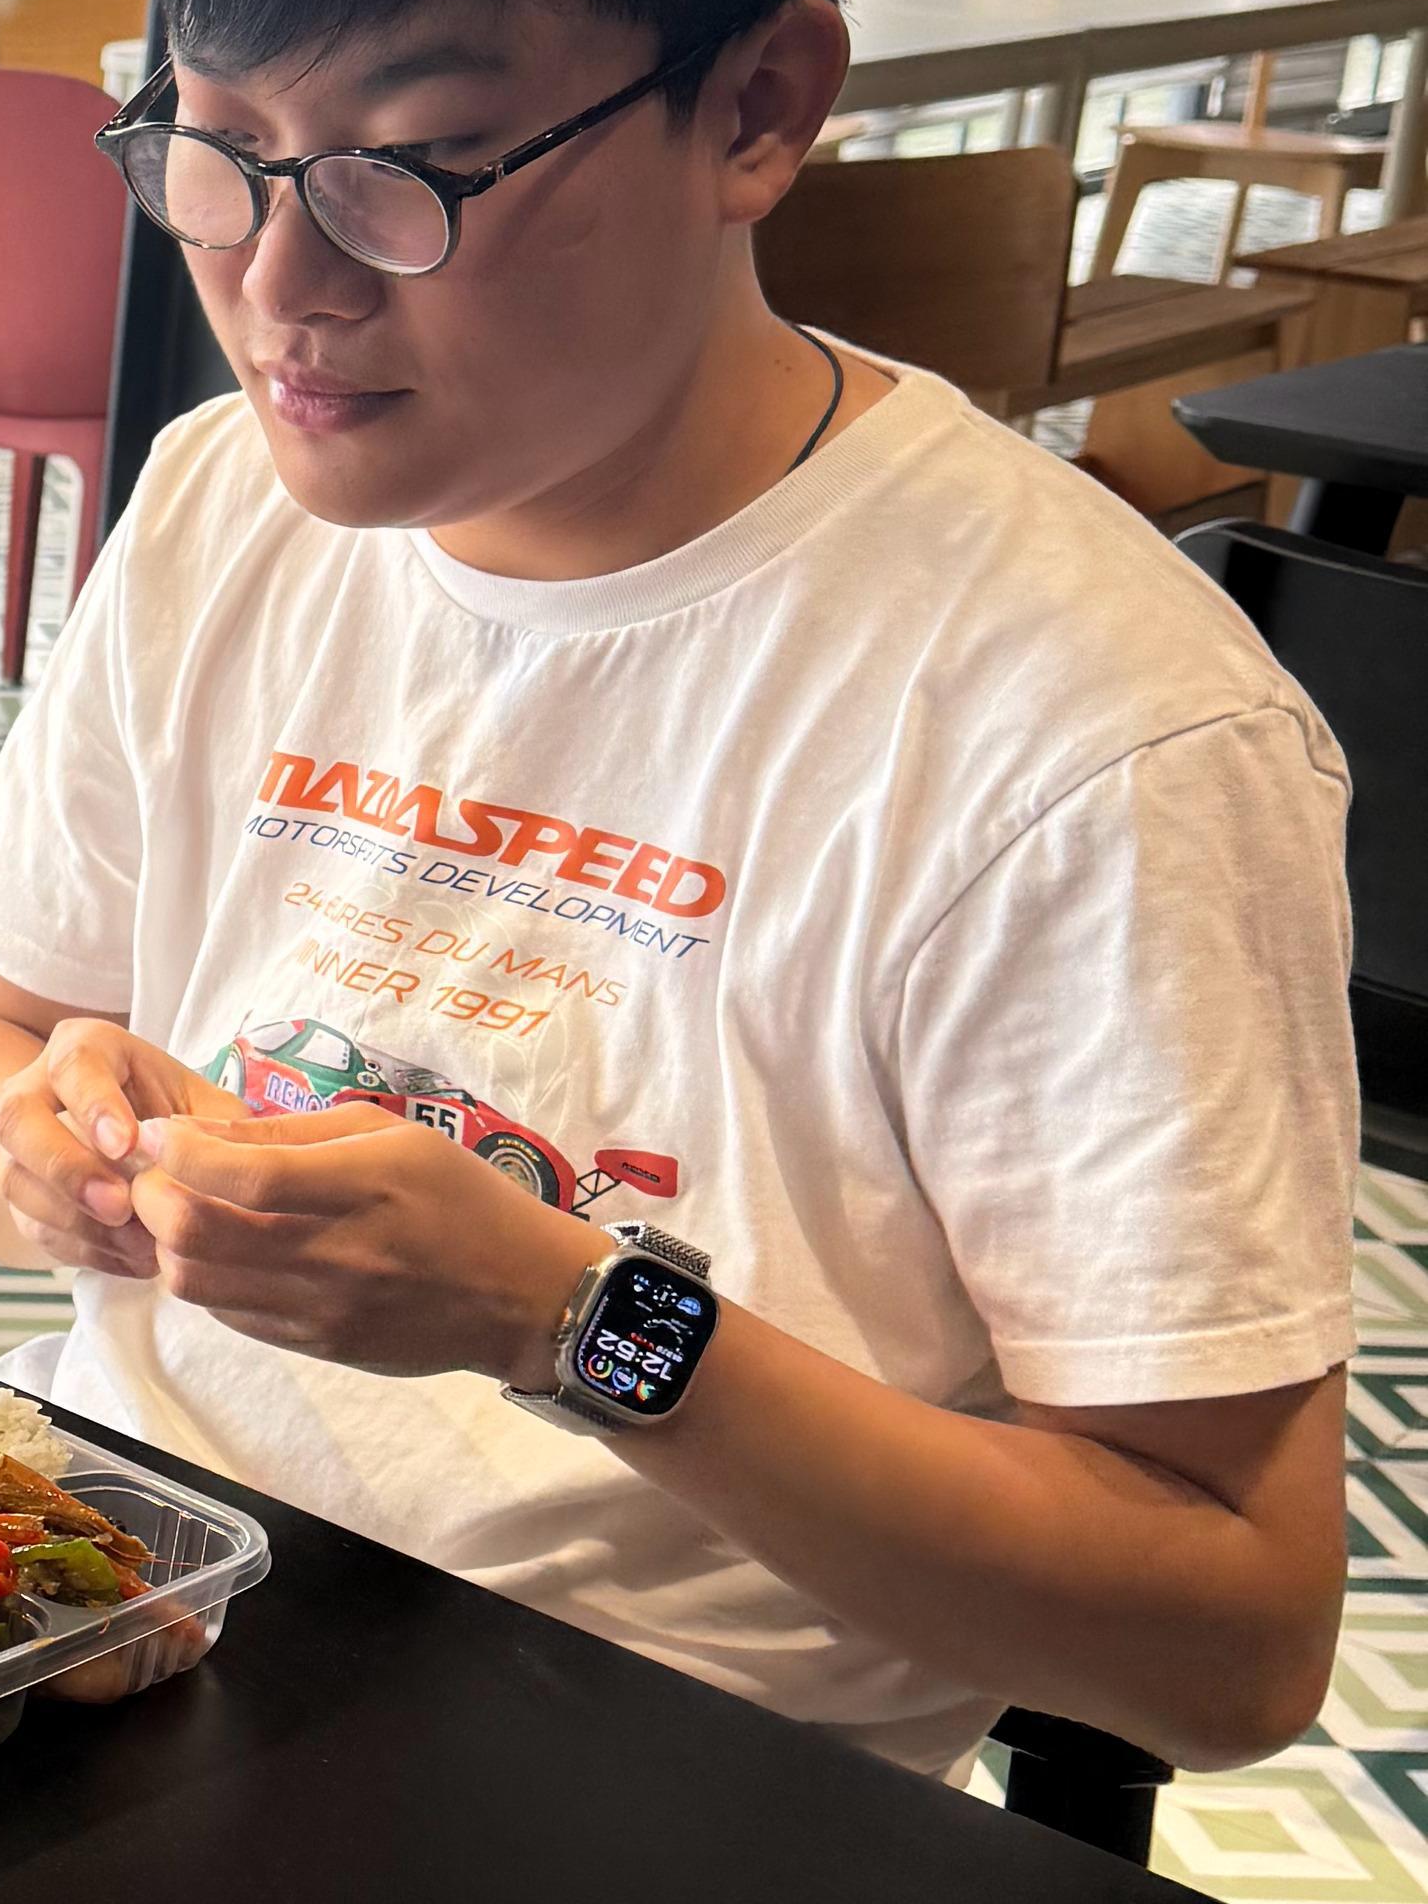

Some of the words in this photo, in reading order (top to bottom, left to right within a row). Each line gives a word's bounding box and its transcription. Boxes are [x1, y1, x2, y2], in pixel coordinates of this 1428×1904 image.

[418, 861, 711, 959] DEVELOPMENT
[414, 929, 490, 963] DU
[489, 948, 628, 1007] MANS
[430, 985, 551, 1037] 1991
[415, 1102, 457, 1140] 55
[595, 1328, 673, 1382] 12:52
